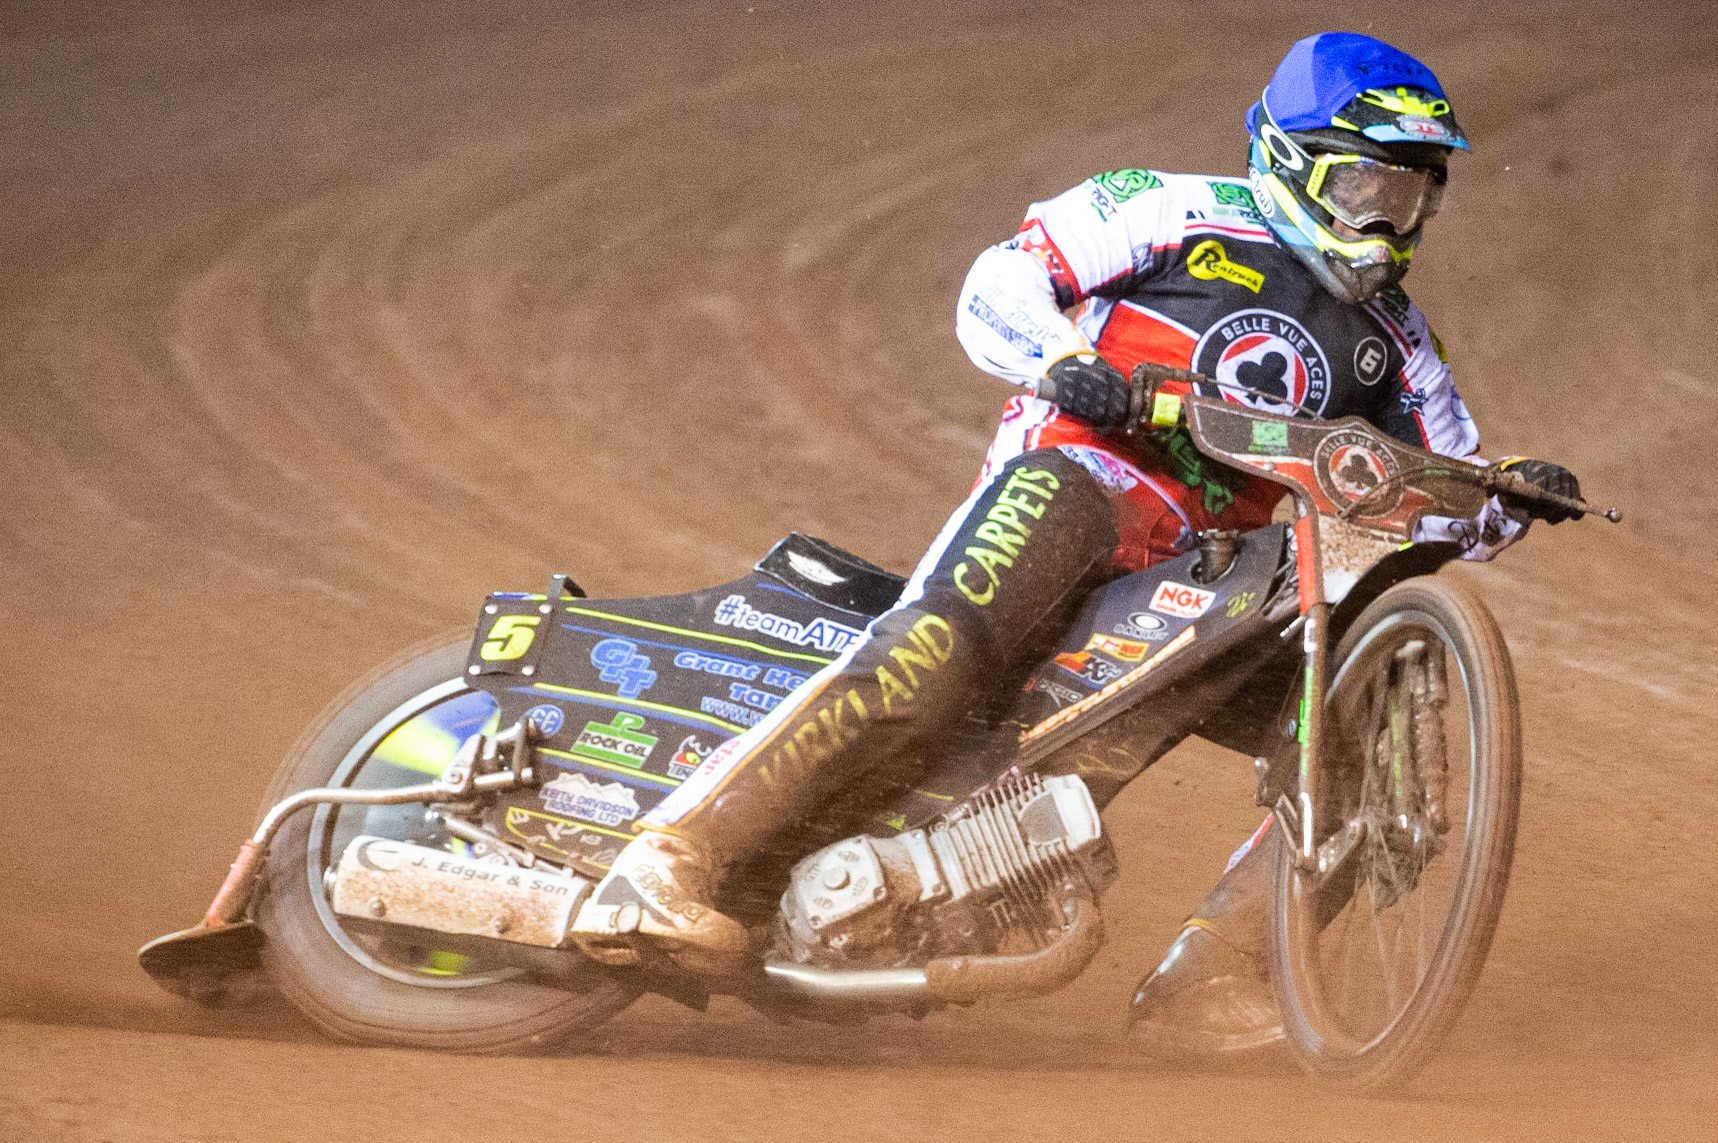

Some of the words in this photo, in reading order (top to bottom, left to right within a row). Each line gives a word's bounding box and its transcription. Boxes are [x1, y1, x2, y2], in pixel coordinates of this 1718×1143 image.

[1221, 318, 1270, 341] BELLE
[1280, 323, 1308, 352] VUE
[1306, 357, 1323, 400] ACES
[1360, 347, 1382, 374] 6
[953, 466, 1060, 606] CARPETS
[1159, 586, 1209, 610] NGK
[480, 615, 541, 662] 5
[674, 651, 761, 680] Grant
[579, 732, 622, 750] ROCK
[624, 742, 647, 758] OIL
[576, 795, 634, 817] DAVIDSON
[598, 810, 620, 824] LTD
[411, 857, 428, 869] J.
[438, 861, 501, 882] Edgar
[507, 875, 521, 887] &
[529, 879, 570, 897] Son
